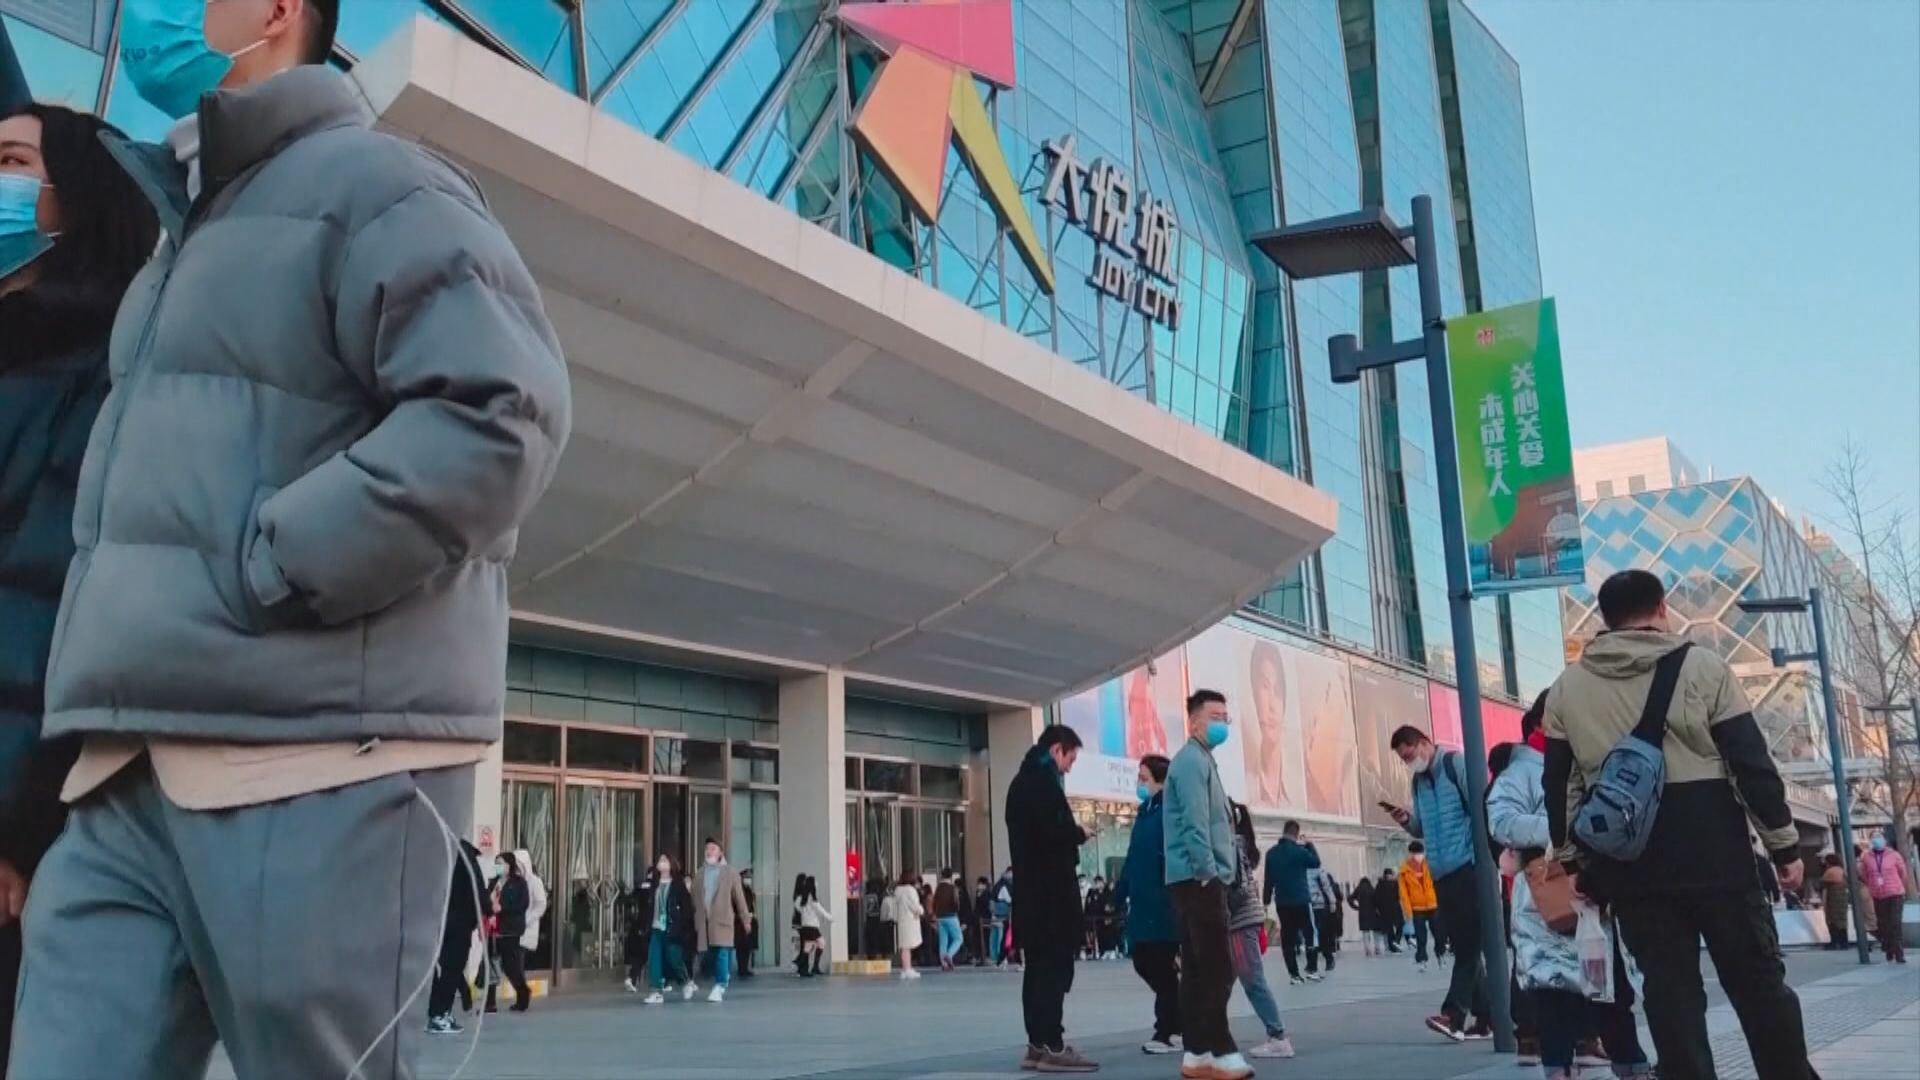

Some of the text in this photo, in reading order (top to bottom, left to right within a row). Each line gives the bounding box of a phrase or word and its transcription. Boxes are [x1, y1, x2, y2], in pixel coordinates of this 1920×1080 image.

[1039, 134, 1178, 286] 大悦城
[1087, 255, 1183, 331] JOY CITY
[1480, 393, 1512, 497] 未成年人
[1510, 361, 1545, 468] 关心关爱
